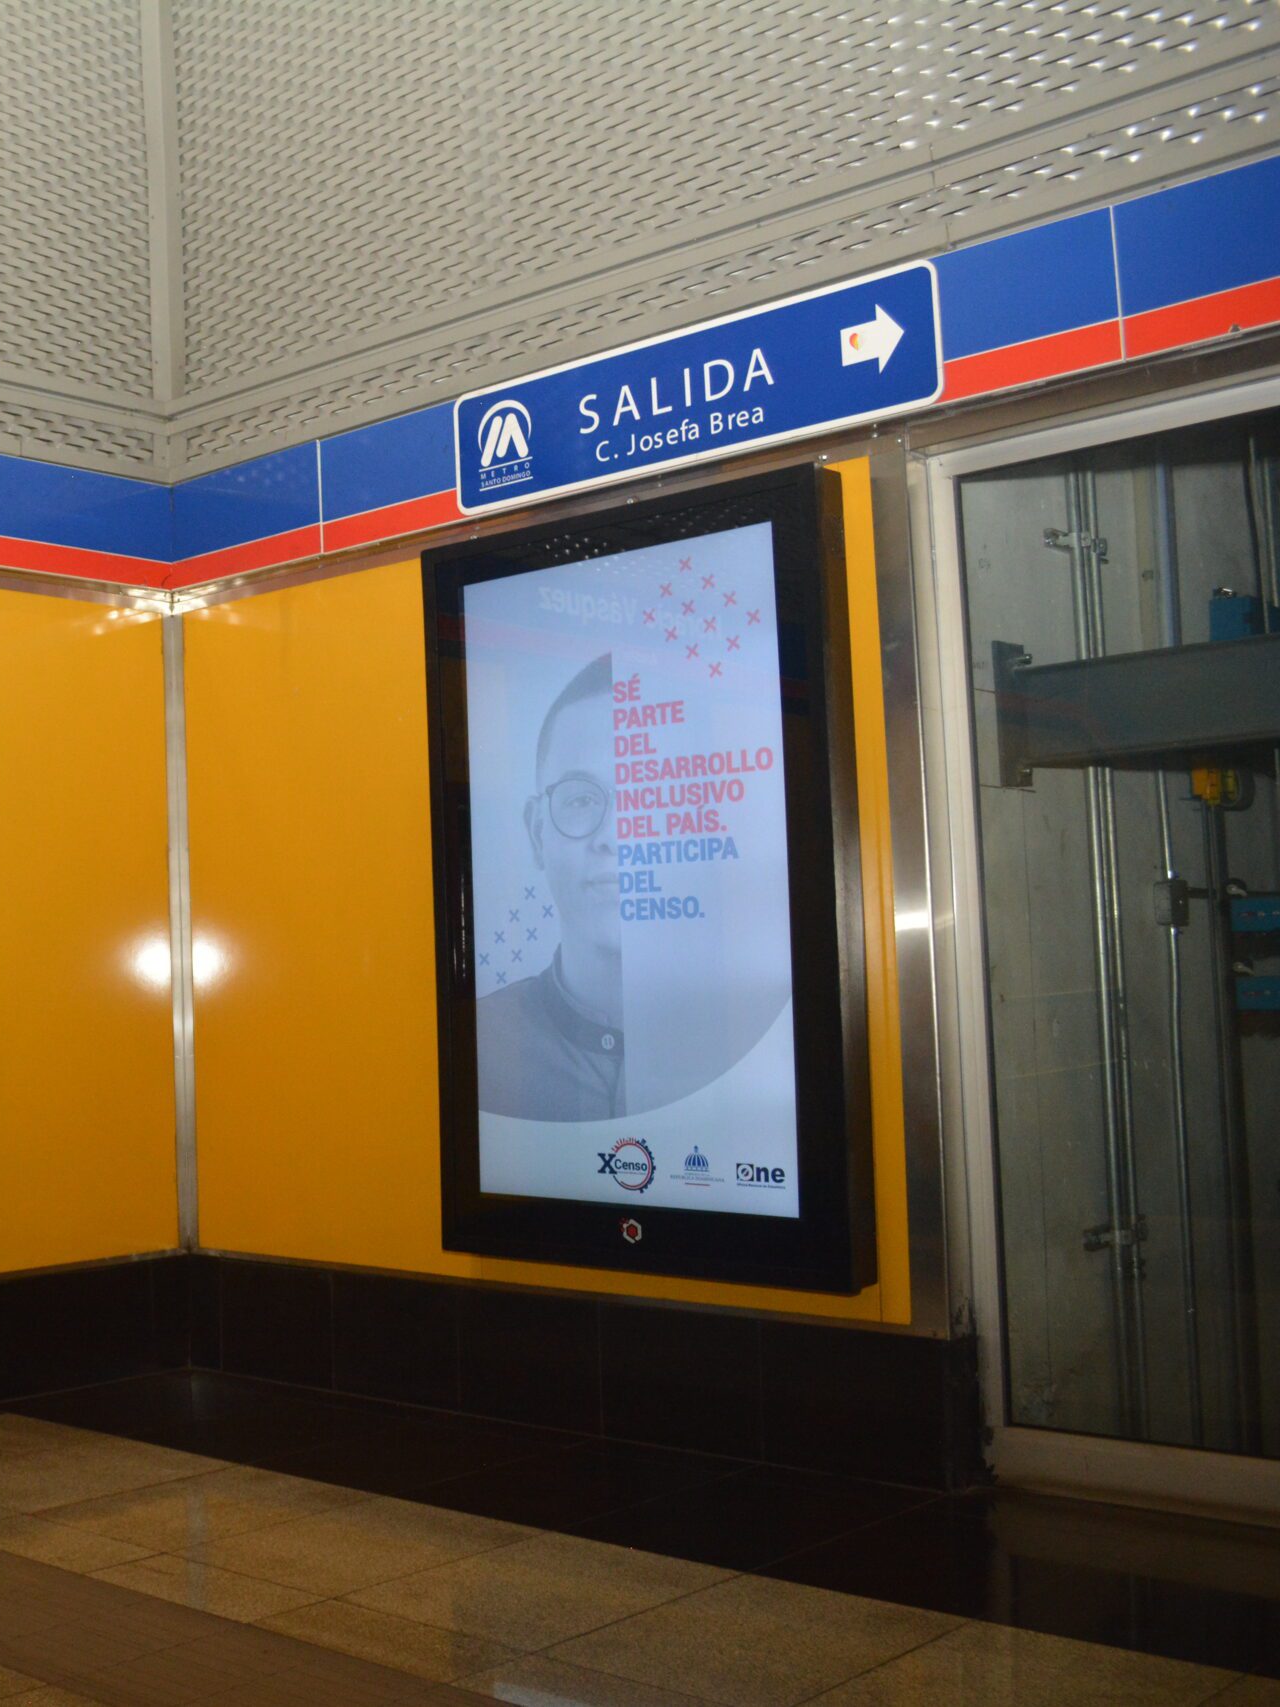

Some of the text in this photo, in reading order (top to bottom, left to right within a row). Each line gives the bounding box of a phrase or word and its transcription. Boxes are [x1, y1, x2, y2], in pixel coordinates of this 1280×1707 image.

[579, 348, 775, 434] SALIDA
[596, 406, 764, 463] C. Josefa Brea
[480, 462, 530, 480] METRO
[481, 470, 531, 488] SANTO DOMINGO
[613, 673, 641, 704] SÉ
[613, 701, 685, 731] PARTE
[614, 732, 657, 758] DEL
[615, 747, 774, 784] DESARROLLO
[616, 778, 745, 812] INCLUSIVO
[617, 804, 728, 839] DEL PAÍS.
[618, 837, 739, 867] PARTICIPA
[619, 870, 662, 894] DEL
[620, 896, 705, 921] CENSO.
